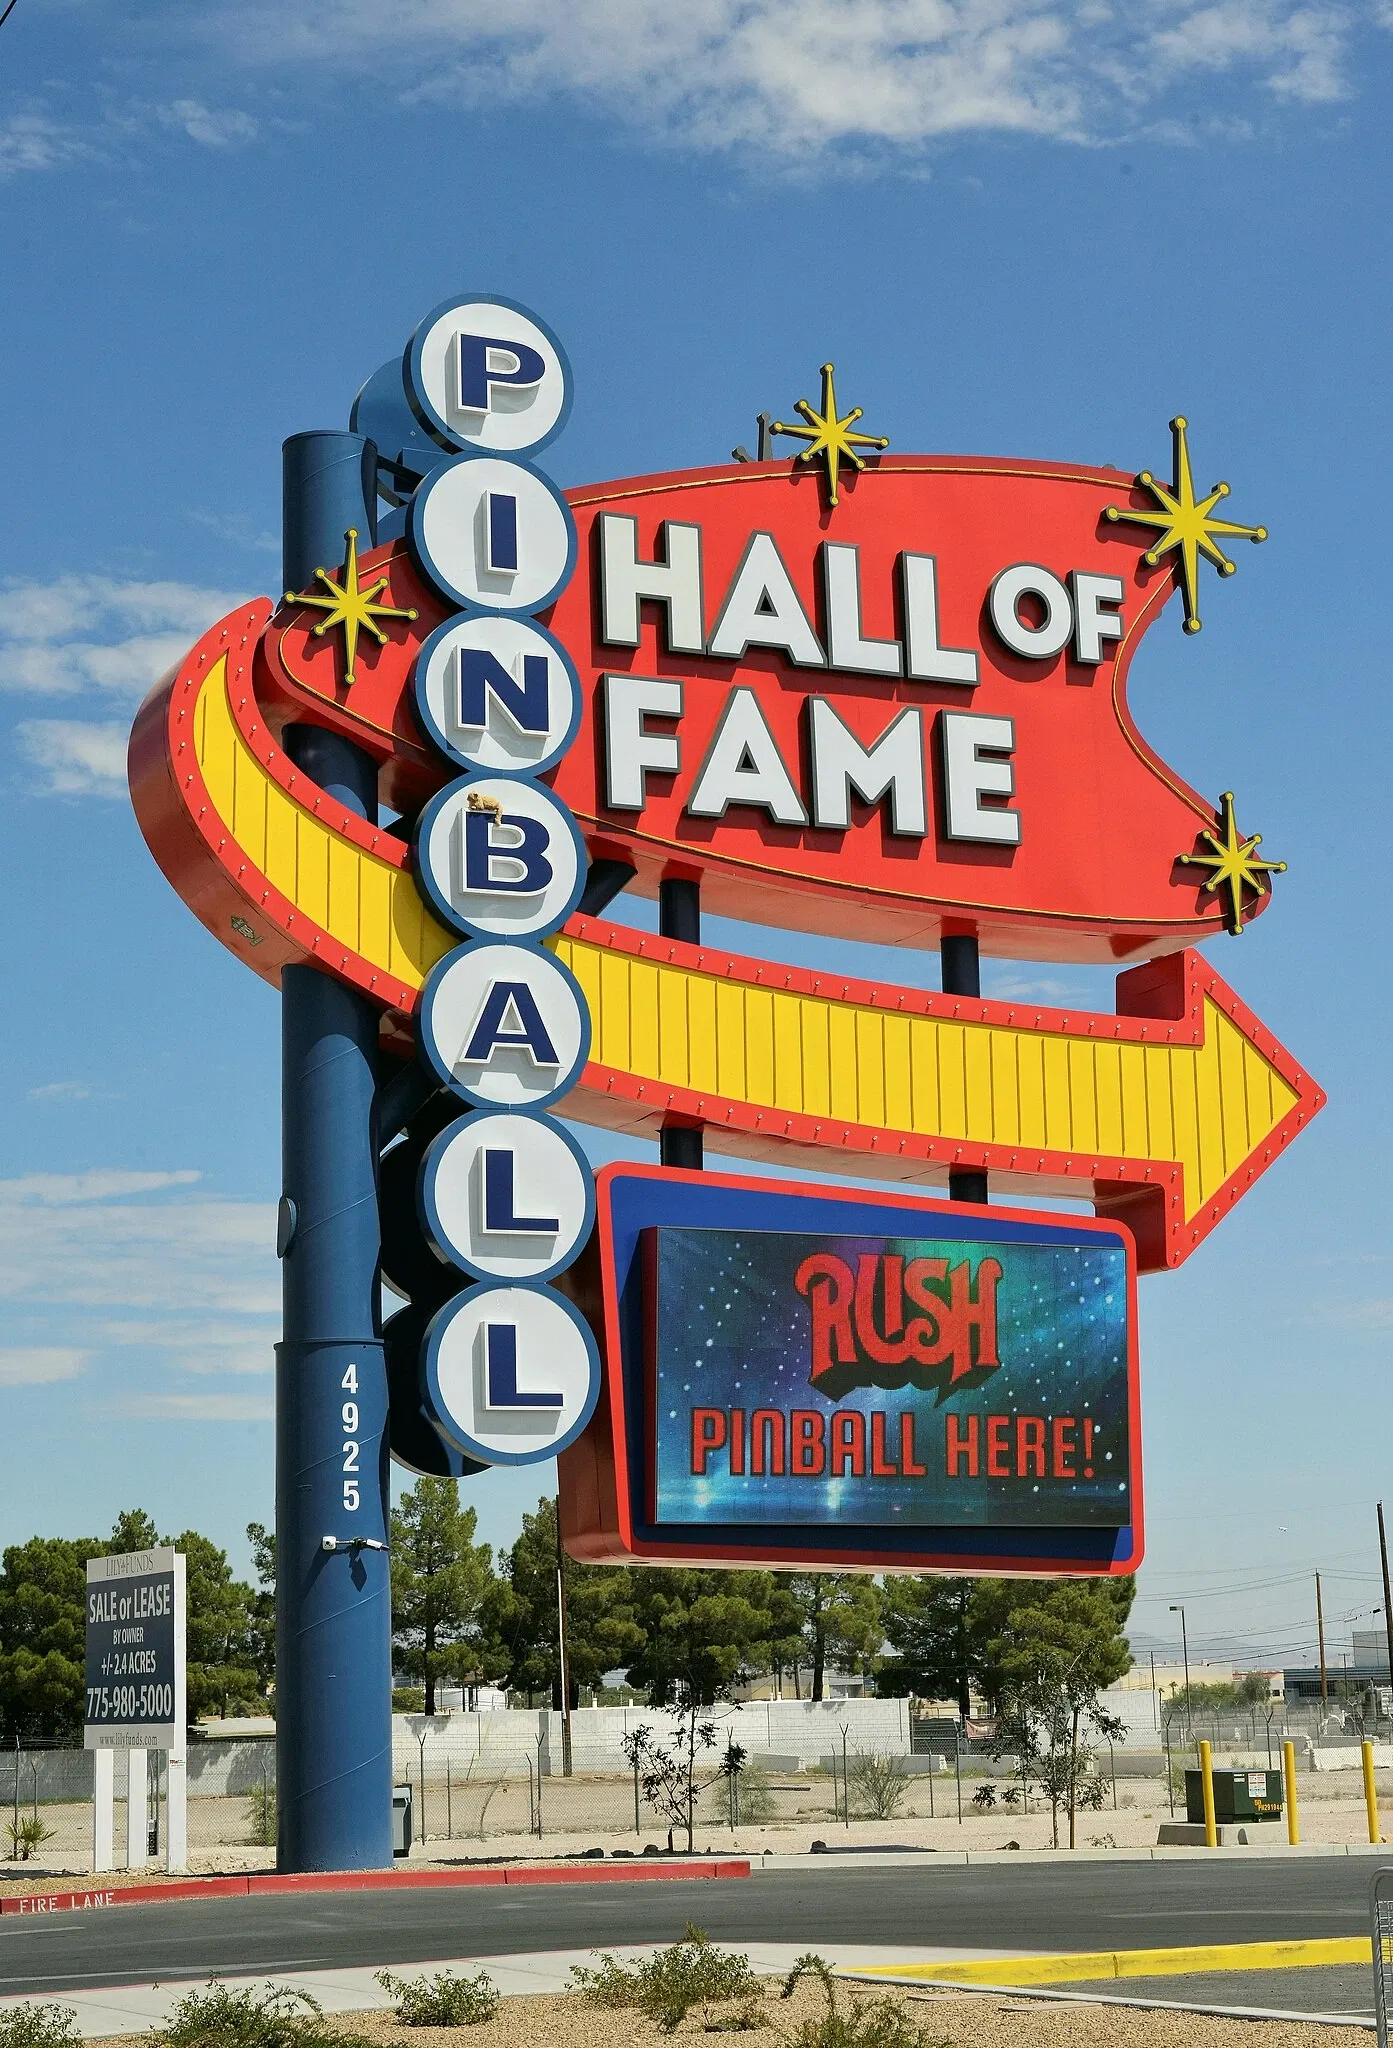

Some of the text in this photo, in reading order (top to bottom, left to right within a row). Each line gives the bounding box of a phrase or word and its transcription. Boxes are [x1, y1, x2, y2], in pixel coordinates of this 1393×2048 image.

[599, 512, 1124, 686] HALL OF
[603, 672, 1022, 845] FAME
[454, 332, 565, 1411] PINBALL
[794, 1253, 1004, 1398] RUSH
[341, 1363, 361, 1512] 4925
[691, 1408, 1095, 1478] PINBALL HERE!
[126, 1553, 154, 1573] FUNDS
[90, 1584, 171, 1623] SALE or LEASE
[113, 1627, 144, 1644] BY OWNER
[101, 1650, 156, 1675] +/- 2.4 ACRES
[87, 1684, 172, 1718] 775-980-5000
[99, 1732, 158, 1749] www.lilyfunds.com
[20, 1892, 115, 1913] FIRE LANE
